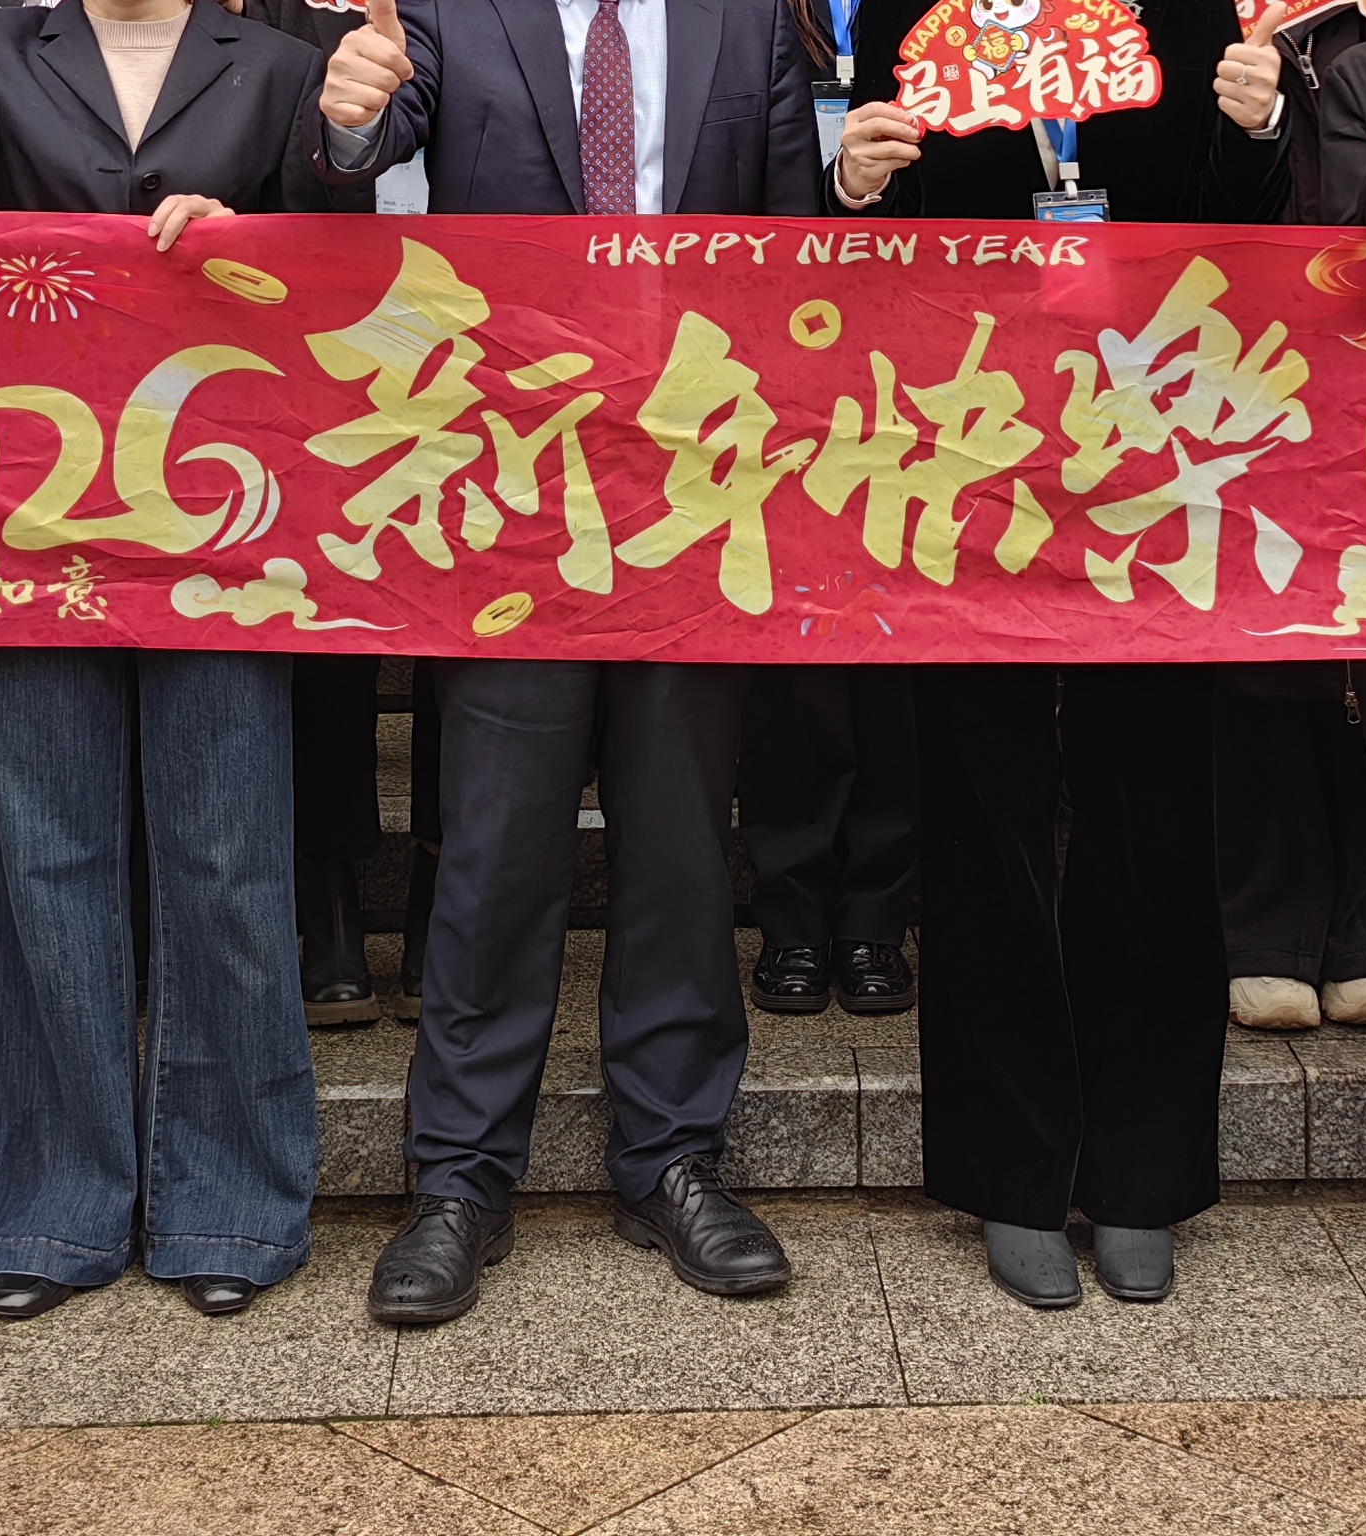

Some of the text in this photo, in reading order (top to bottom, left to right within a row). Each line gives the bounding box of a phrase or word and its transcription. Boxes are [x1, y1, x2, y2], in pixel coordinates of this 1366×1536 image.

[981, 31, 1009, 60] 福
[897, 29, 1158, 131] 马上有福
[587, 232, 1089, 266] HAPPY NEW YEAR
